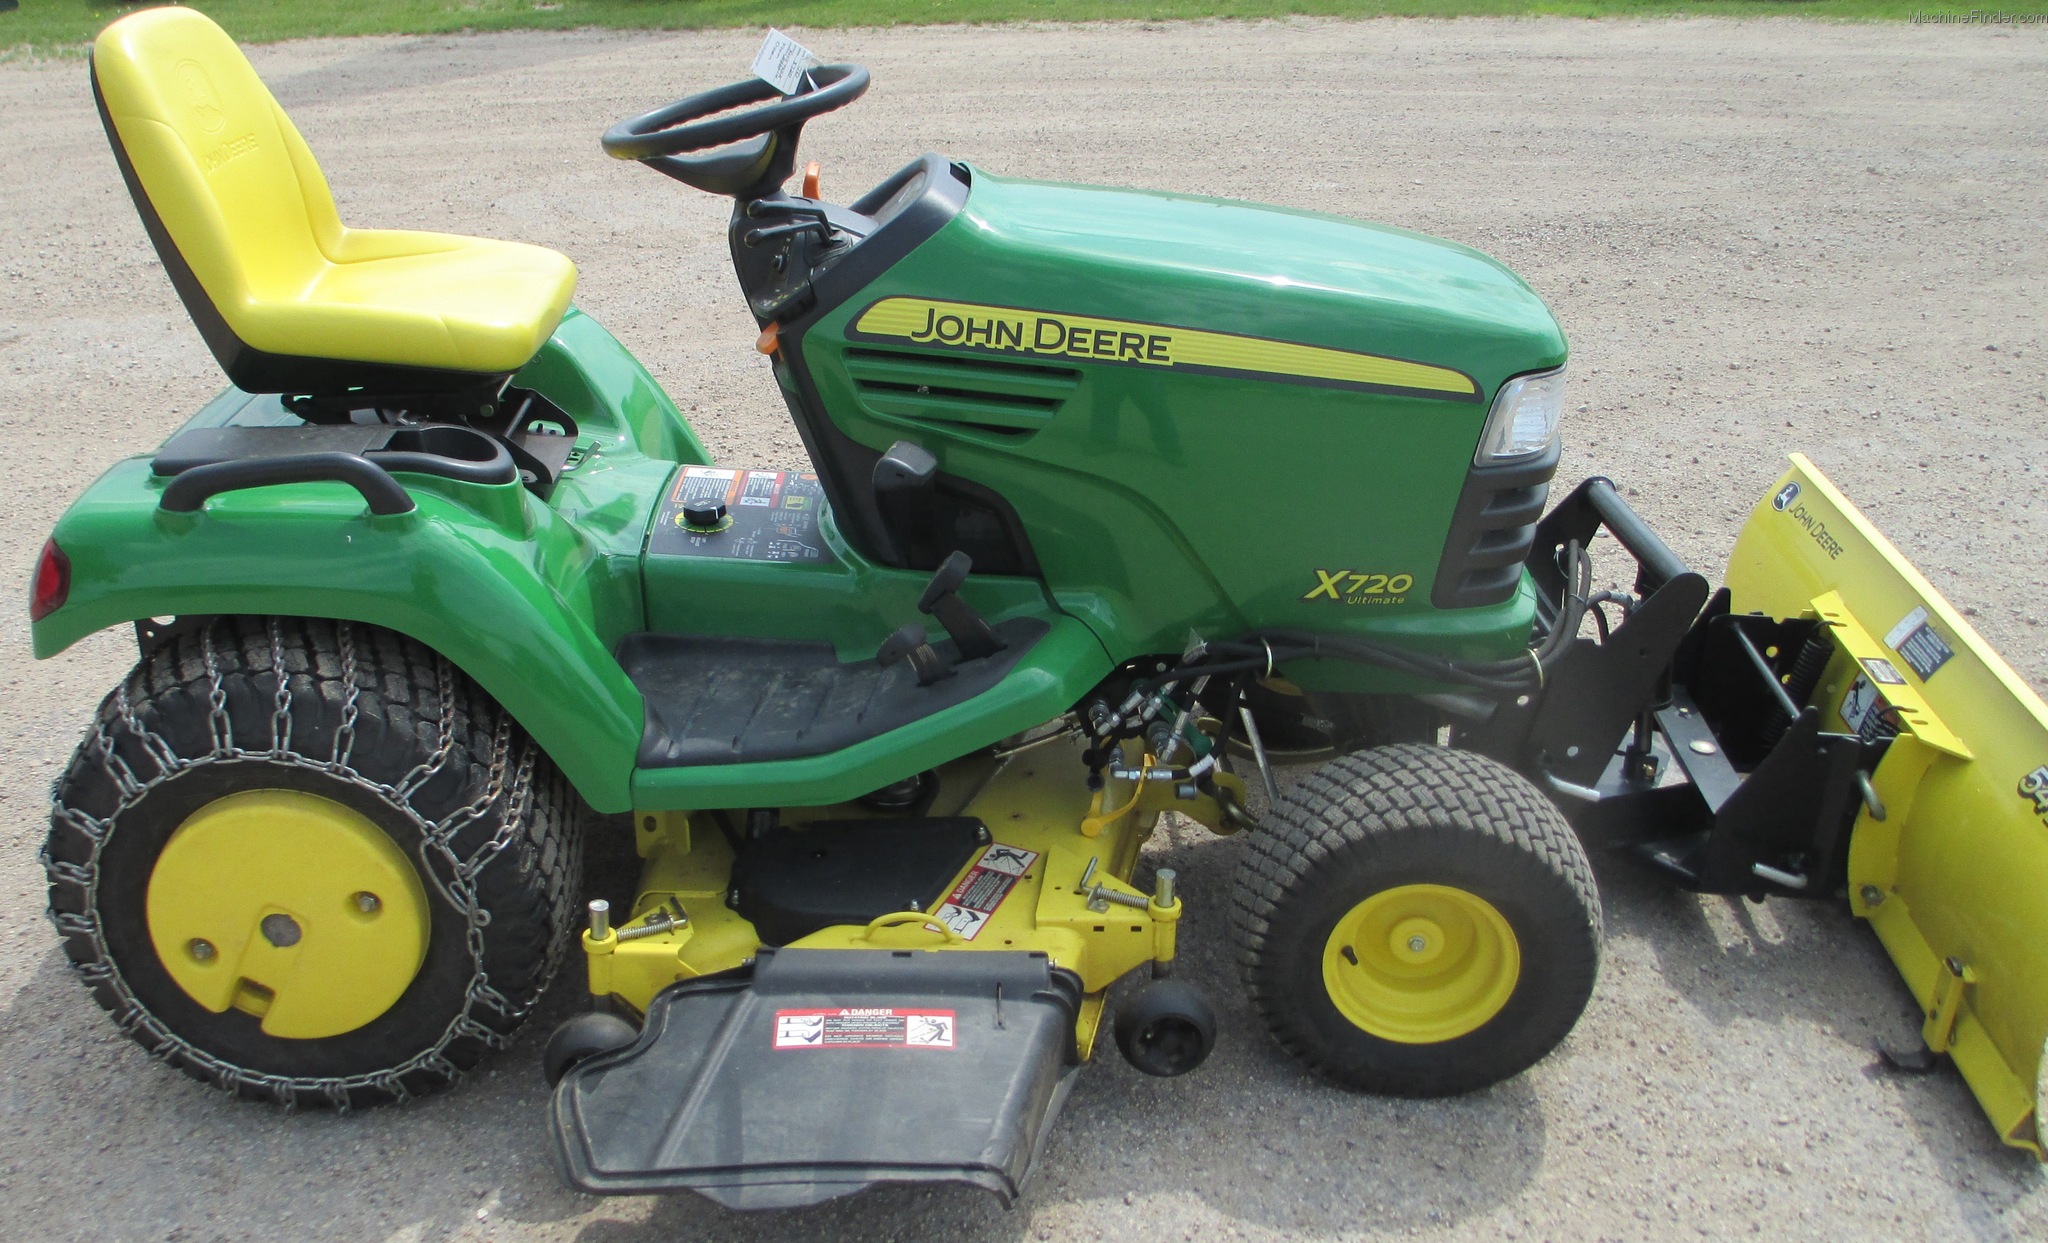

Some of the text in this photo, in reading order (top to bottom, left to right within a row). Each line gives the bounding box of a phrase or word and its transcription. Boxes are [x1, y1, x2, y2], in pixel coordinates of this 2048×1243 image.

[911, 307, 1173, 362] JOHN DEERE
[1788, 501, 1844, 561] JOHN DEERE
[1302, 569, 1413, 600] X720
[1347, 596, 1405, 605] Ultimate
[956, 870, 980, 893] DANGER
[850, 1008, 893, 1016] DANGER
